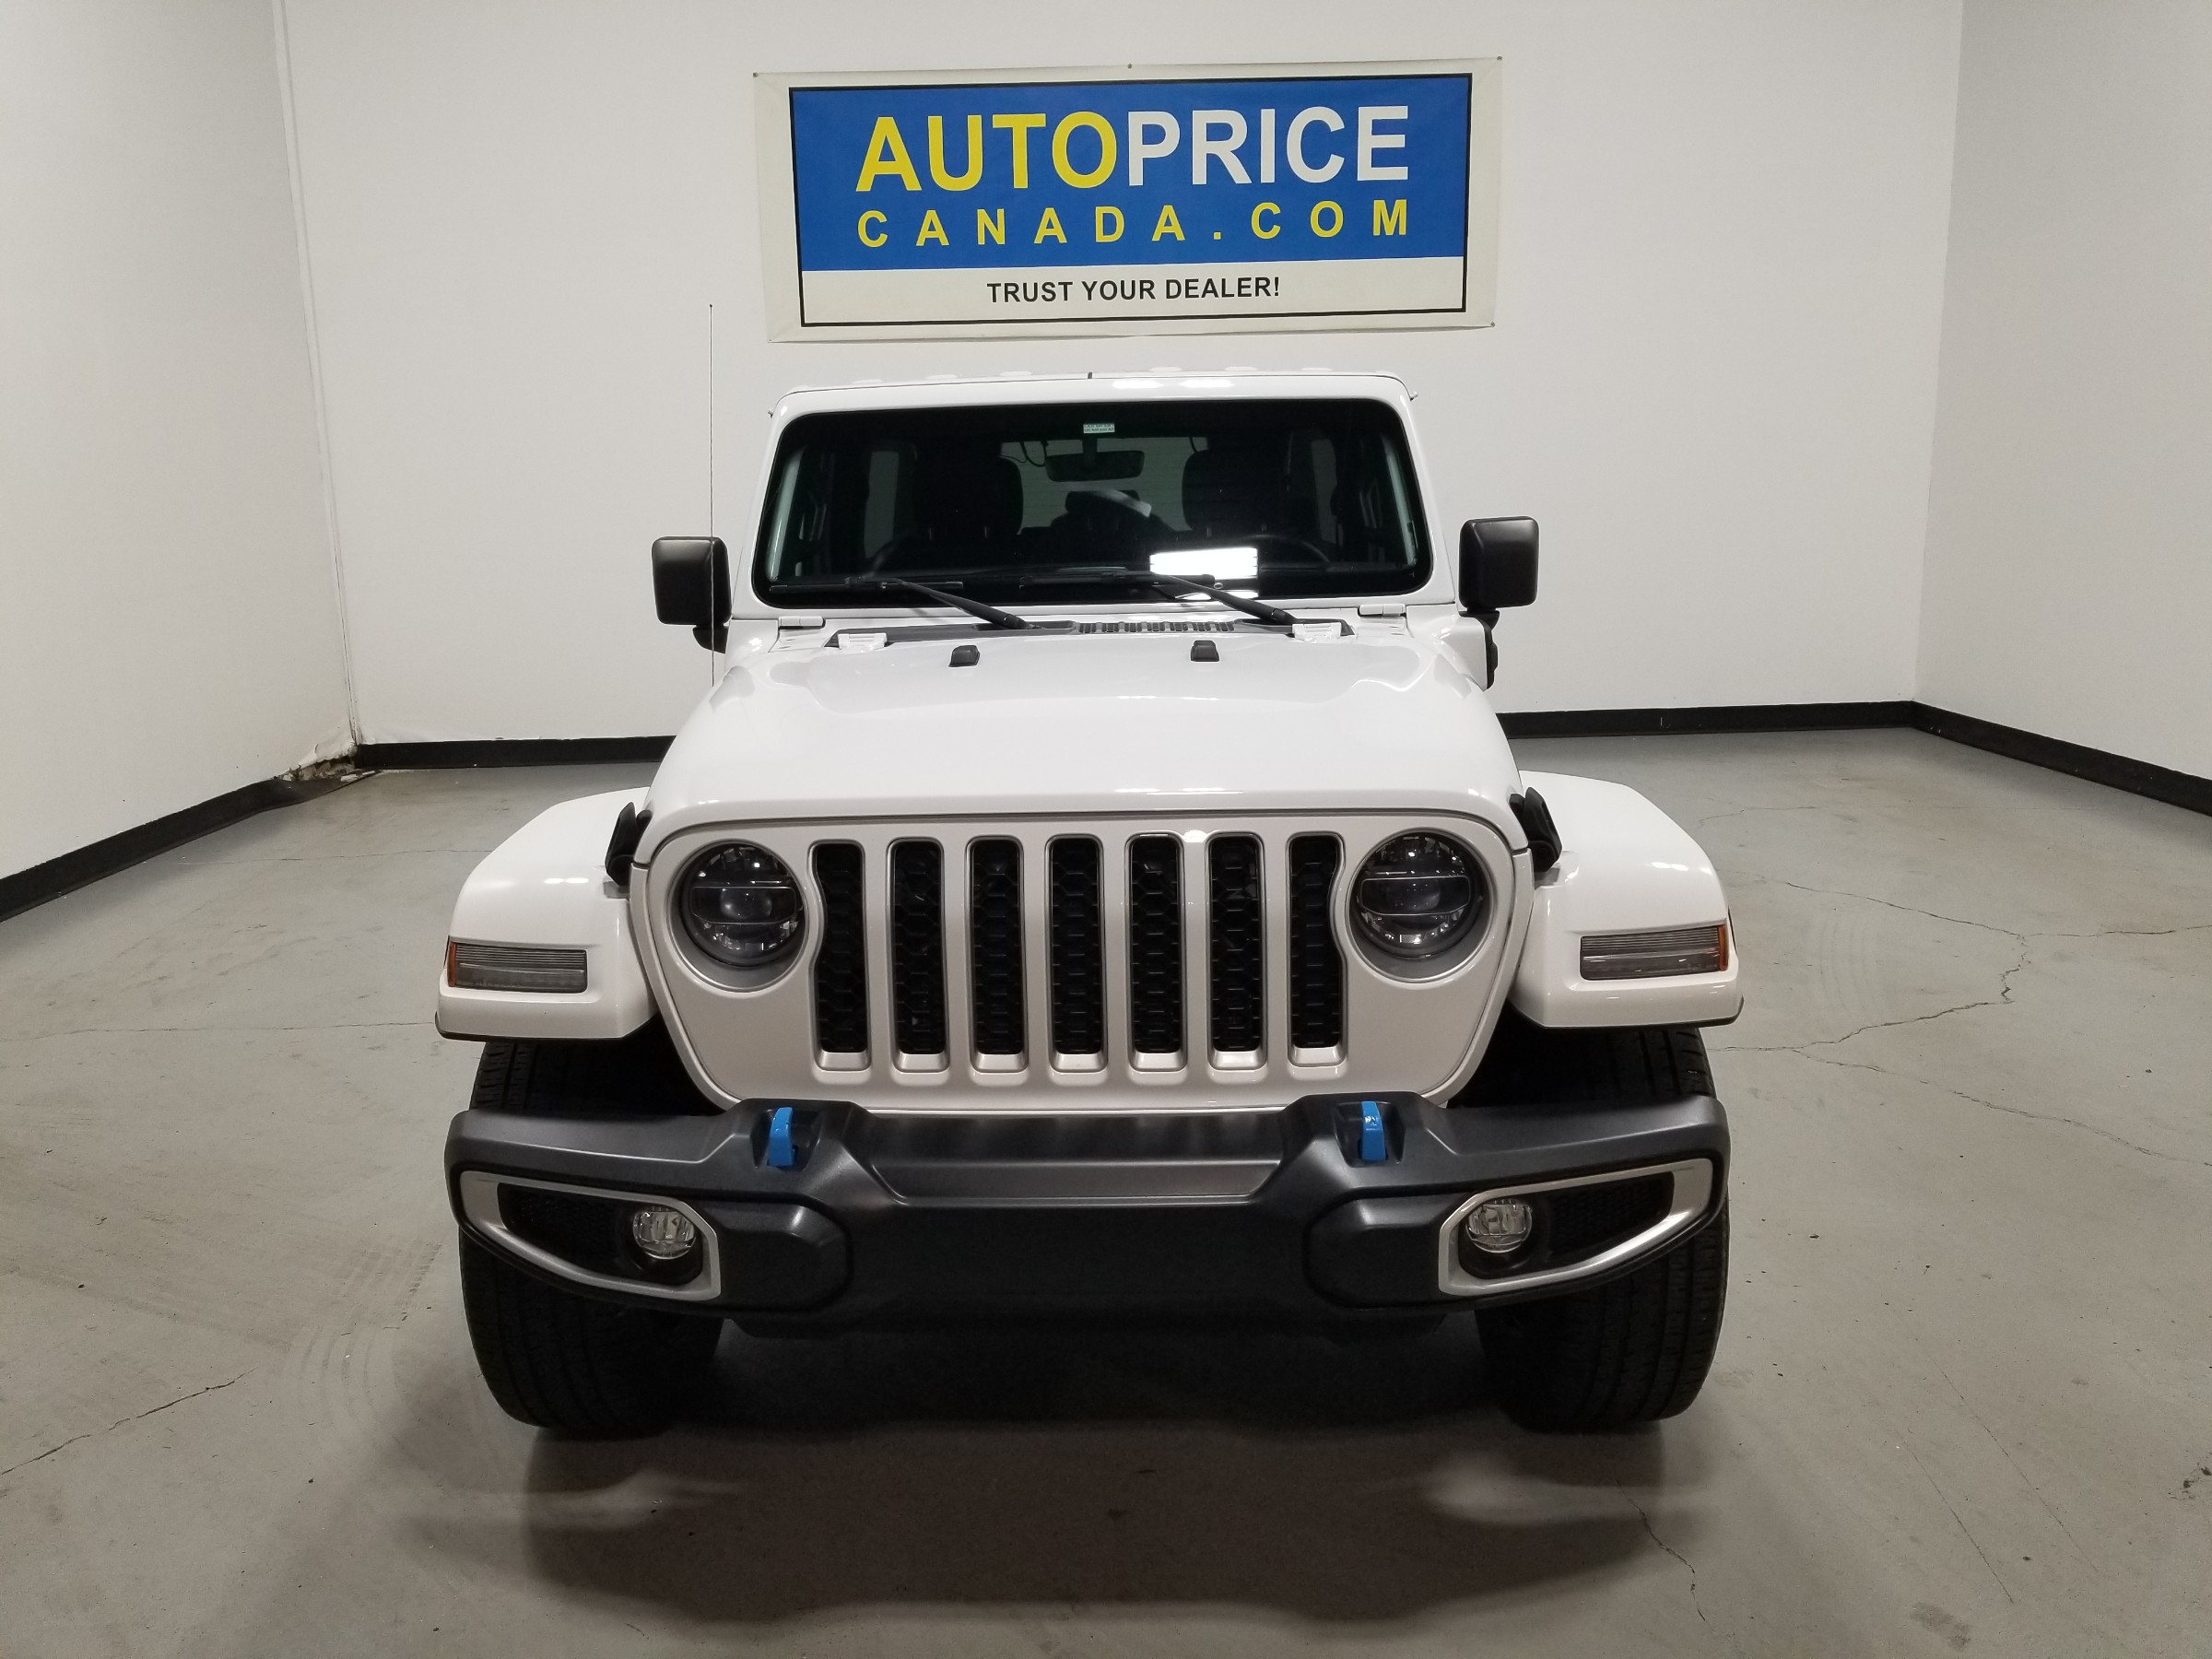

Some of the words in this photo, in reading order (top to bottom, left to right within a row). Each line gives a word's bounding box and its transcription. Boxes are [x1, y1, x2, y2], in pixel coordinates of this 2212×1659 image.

[855, 105, 1409, 192] AUTOPRICE
[986, 280, 1074, 303] TRUST
[1081, 278, 1157, 301] YOUR
[1165, 276, 1280, 300] DEALER!
